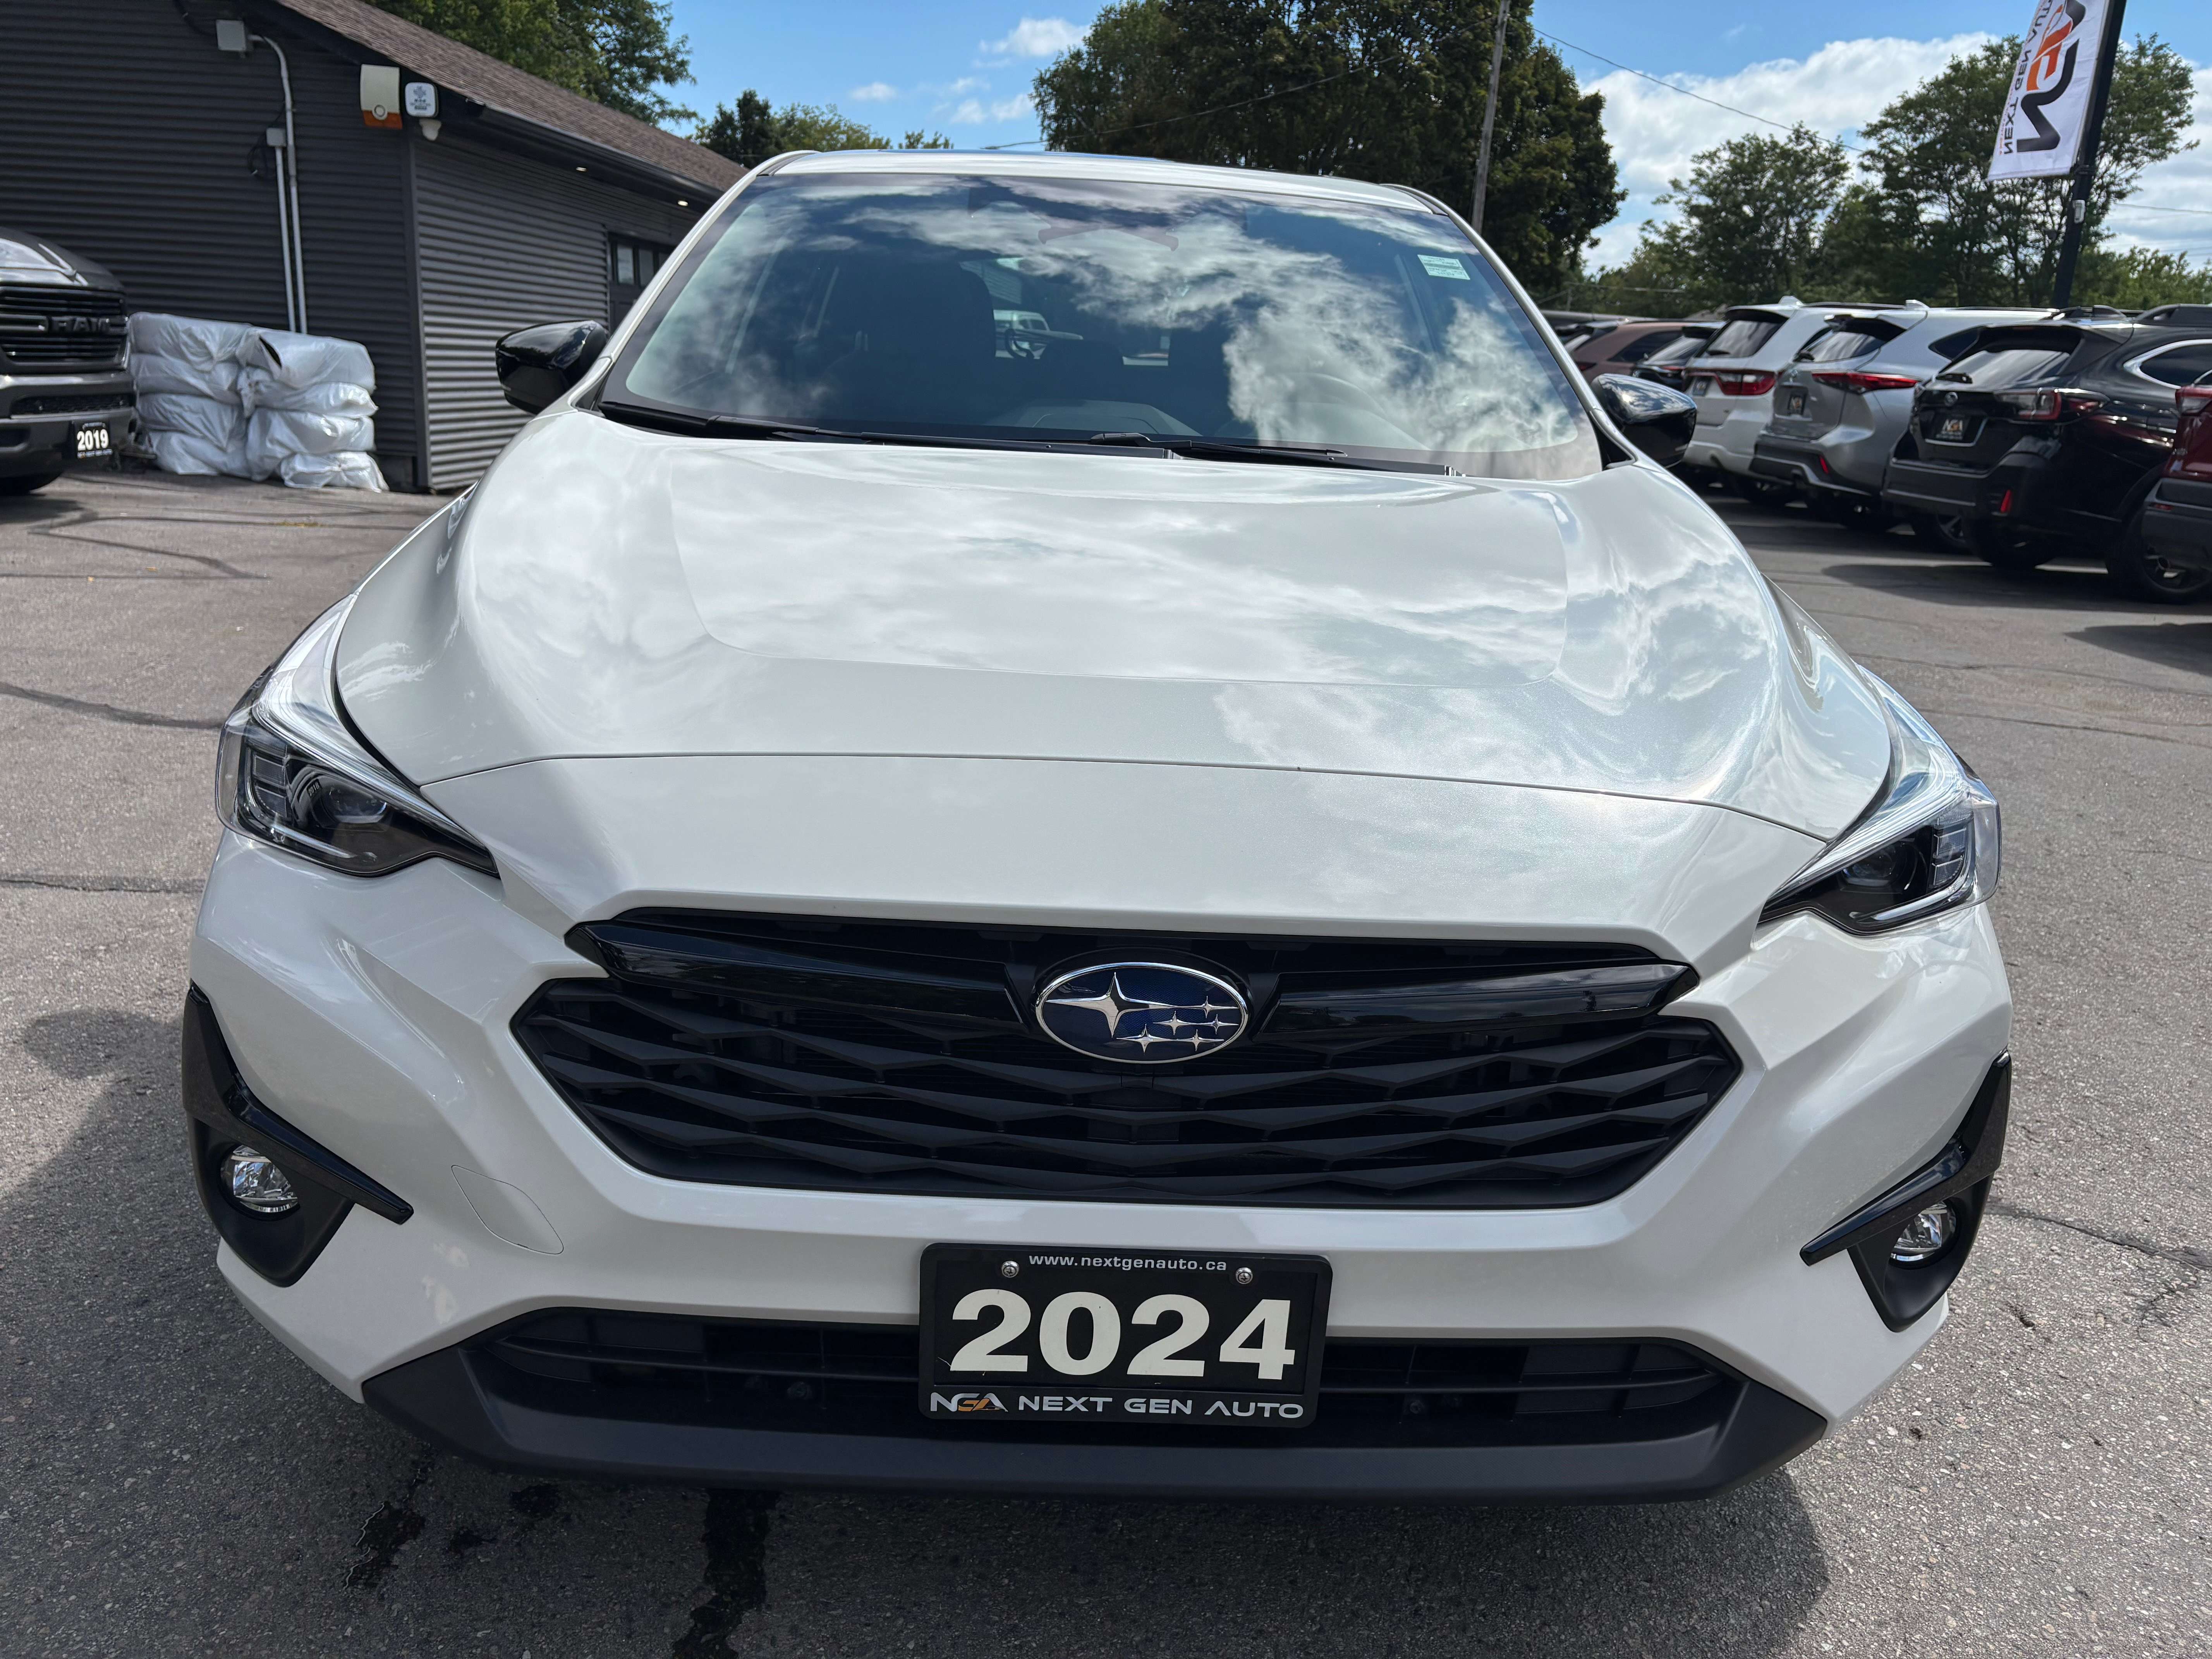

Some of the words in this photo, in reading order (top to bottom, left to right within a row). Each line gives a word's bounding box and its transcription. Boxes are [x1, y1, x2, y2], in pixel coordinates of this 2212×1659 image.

[77, 429, 109, 451] 2019
[1029, 1255, 1227, 1271] www.nextgenauto.ca
[950, 1288, 1295, 1380] 2024
[1018, 1395, 1113, 1412] NEXT
[1124, 1398, 1192, 1415] GEN
[1204, 1401, 1304, 1419] AUTO
